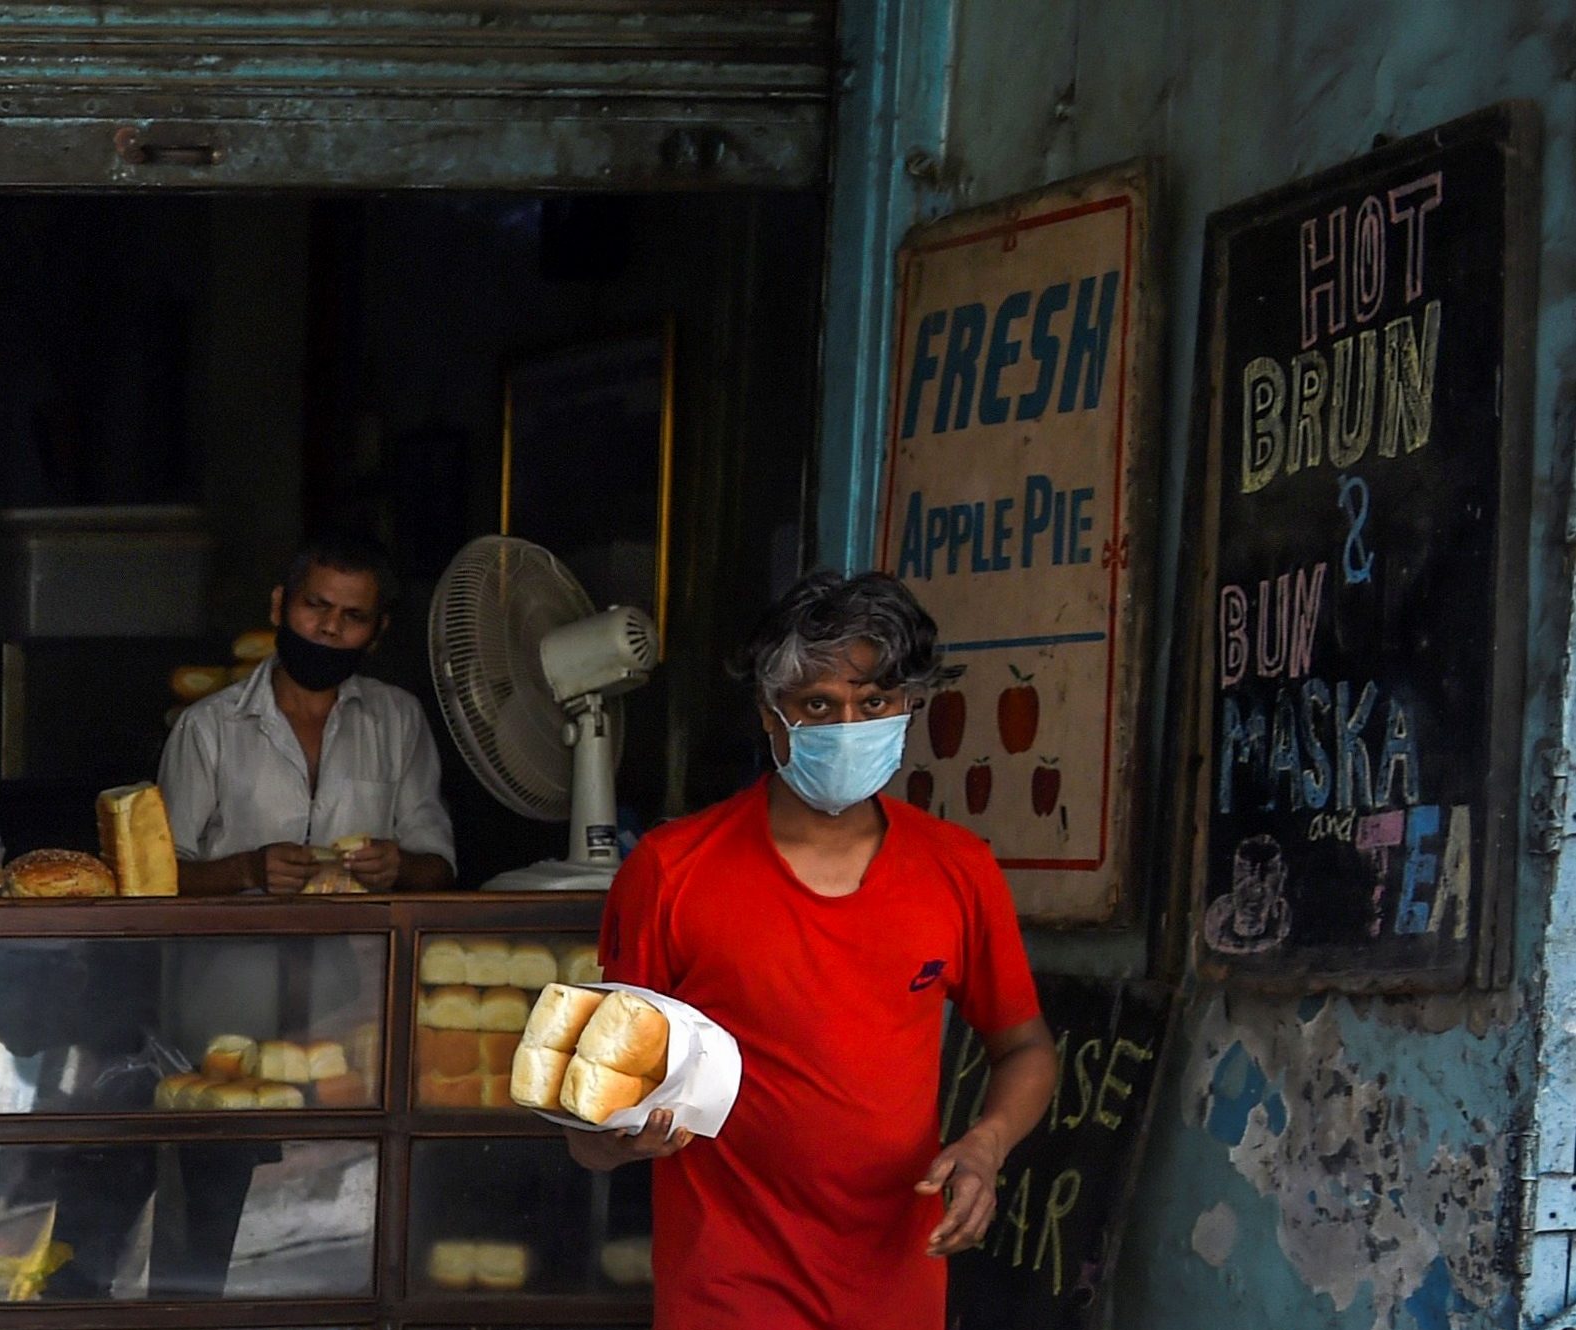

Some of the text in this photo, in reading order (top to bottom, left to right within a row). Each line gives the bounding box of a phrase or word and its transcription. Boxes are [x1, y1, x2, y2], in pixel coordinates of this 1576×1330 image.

[1301, 170, 1443, 347] HOT
[900, 270, 1120, 440] FRESH
[1244, 301, 1441, 495] BRUN
[897, 473, 1096, 580] APPLE PIE
[1219, 562, 1328, 688] BUN
[1220, 678, 1421, 814] MASKA
[1355, 804, 1469, 940] TEA
